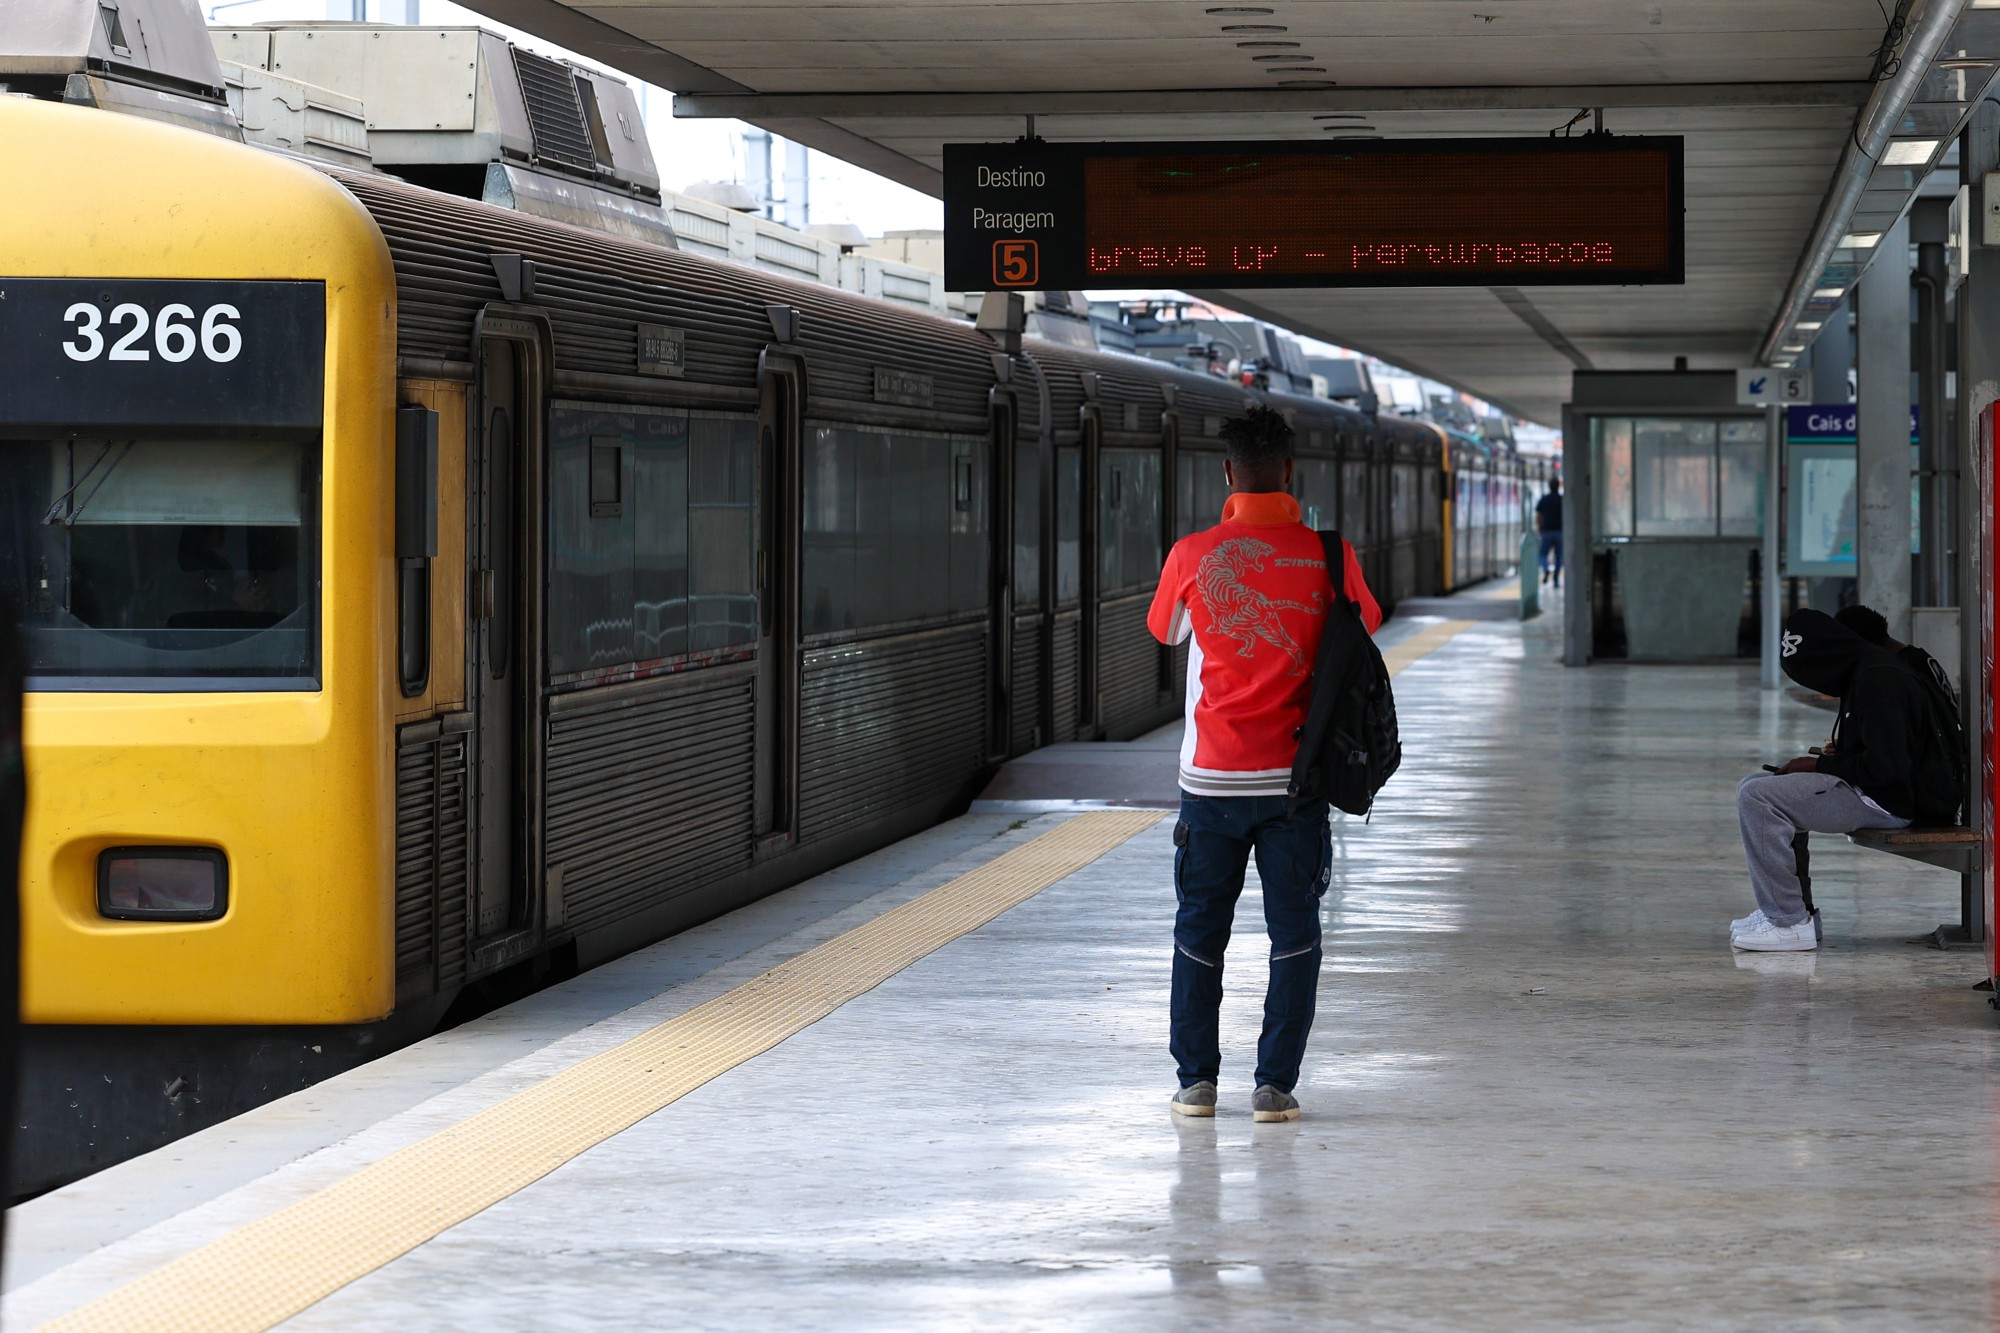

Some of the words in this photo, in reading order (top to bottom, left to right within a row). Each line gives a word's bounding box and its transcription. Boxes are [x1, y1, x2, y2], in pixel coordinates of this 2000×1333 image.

[977, 166, 1046, 188] Destino
[972, 207, 1055, 234] Paragem
[1003, 245, 1028, 281] 5
[62, 302, 243, 364] 3266
[1788, 380, 1799, 398] 5
[1808, 414, 1842, 431] Cais
[1845, 414, 1857, 432] d
